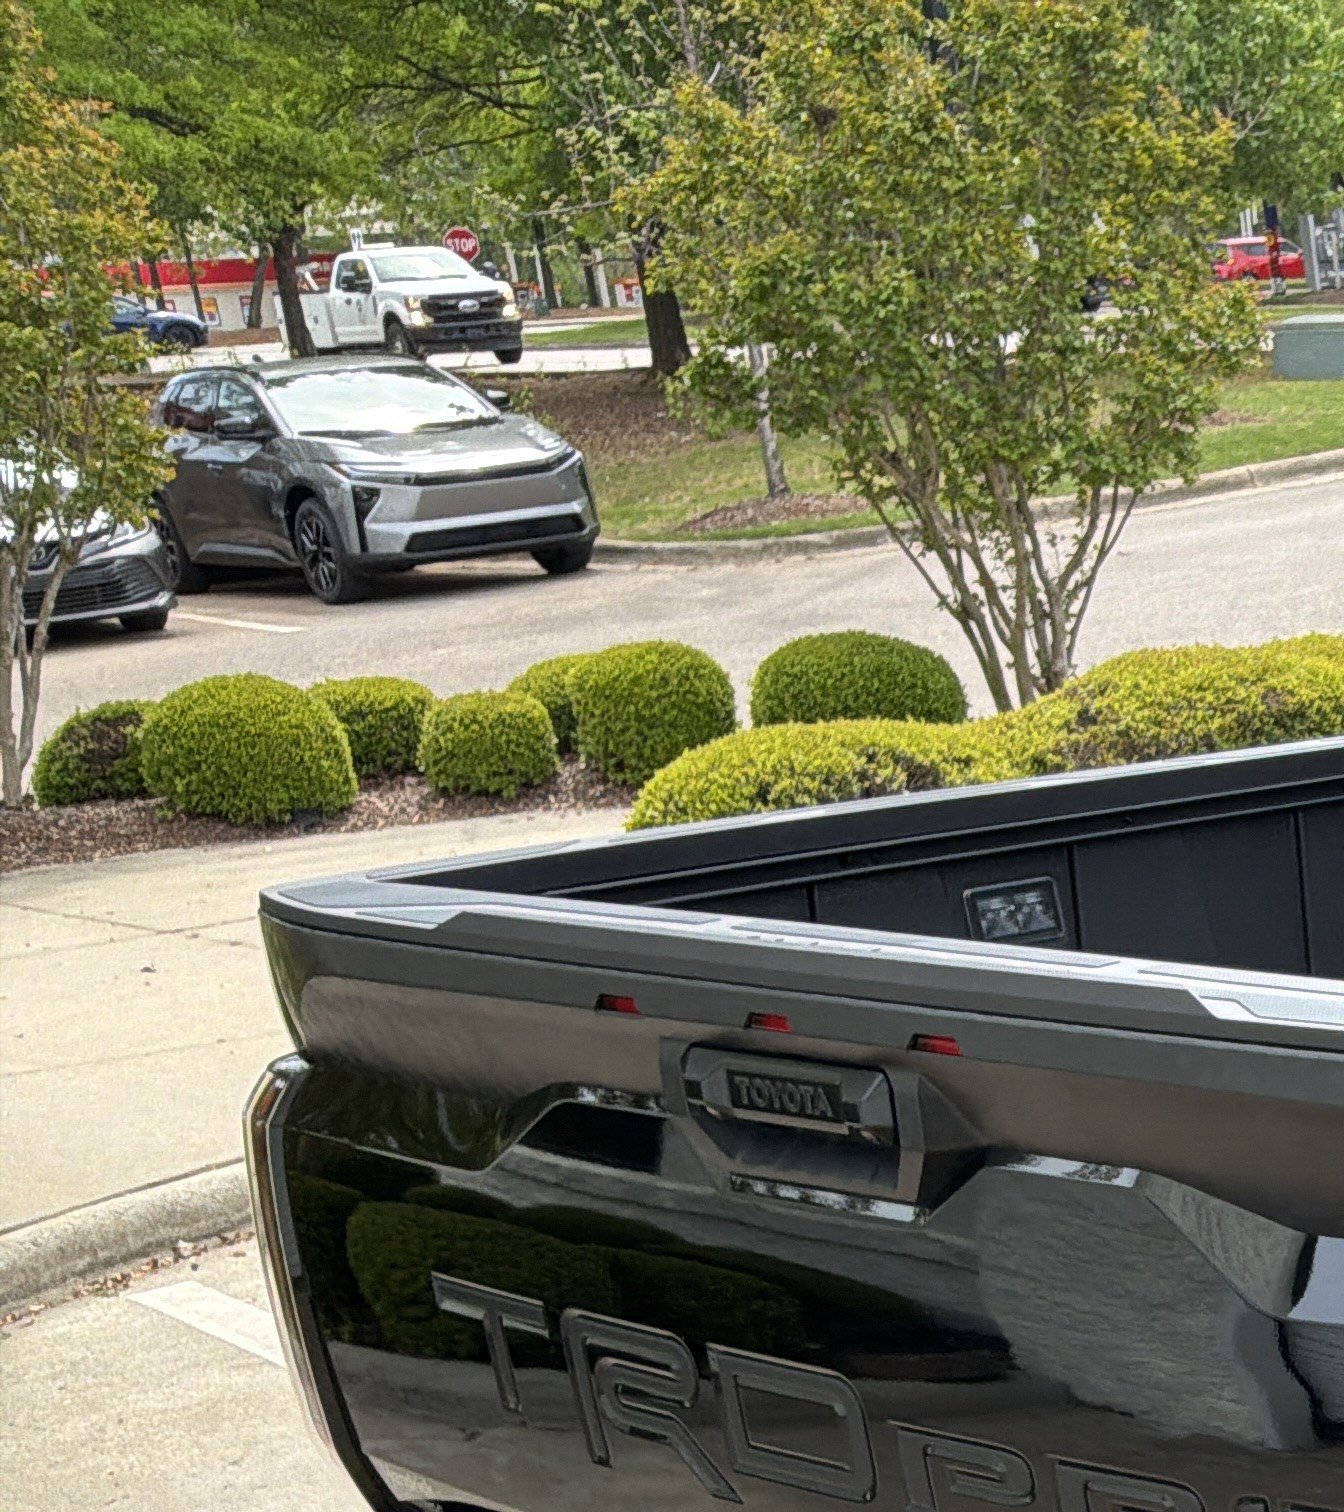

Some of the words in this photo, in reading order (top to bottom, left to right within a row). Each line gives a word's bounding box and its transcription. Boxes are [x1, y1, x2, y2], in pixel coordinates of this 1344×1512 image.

[446, 238, 476, 253] STOP
[732, 1073, 835, 1119] TOYOTA
[430, 1271, 877, 1505] TRD
